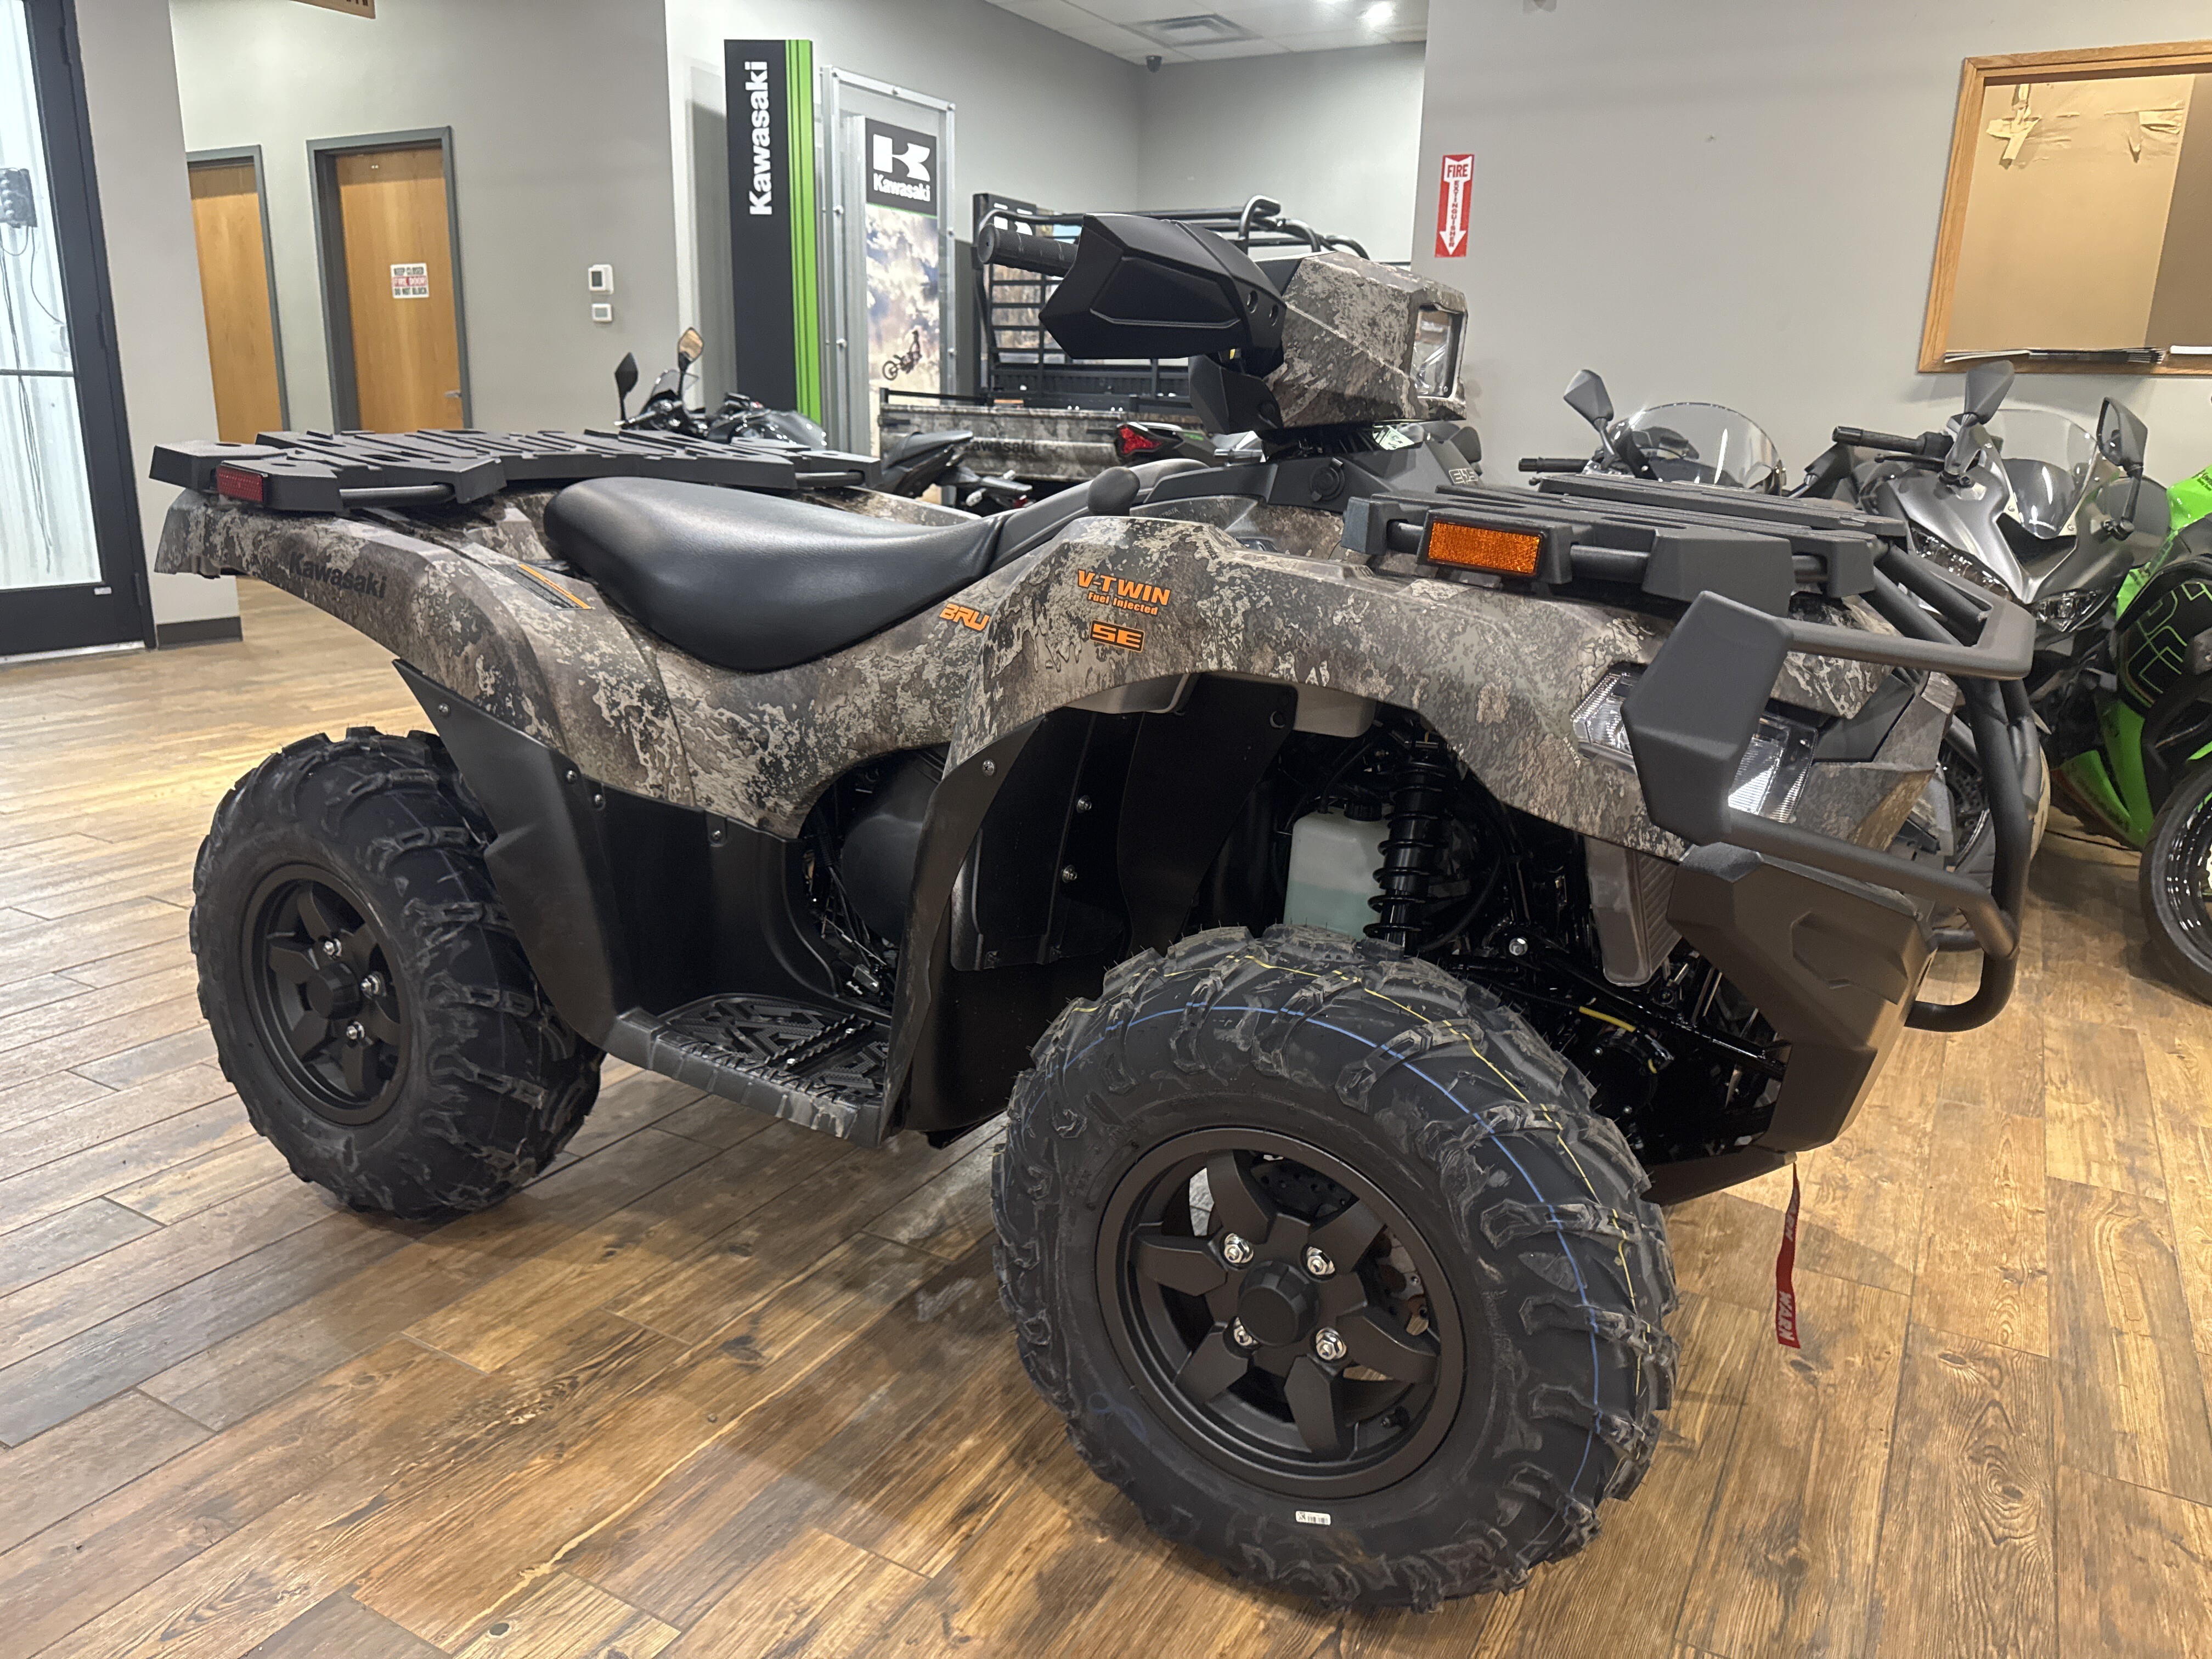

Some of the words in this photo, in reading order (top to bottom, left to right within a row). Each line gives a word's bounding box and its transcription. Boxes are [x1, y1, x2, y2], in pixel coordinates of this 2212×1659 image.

[744, 61, 772, 215] Kawasaki
[1447, 164, 1469, 178] FIRE
[873, 173, 930, 202] Kawasaki
[965, 440, 1035, 454] awasaki
[289, 551, 387, 599] Kawasaki
[1078, 569, 1171, 606] V-TWIN
[1088, 591, 1110, 604] Fuel
[1113, 597, 1159, 616] Injected
[1092, 623, 1142, 648] SE
[1779, 1291, 1795, 1341] WARN
